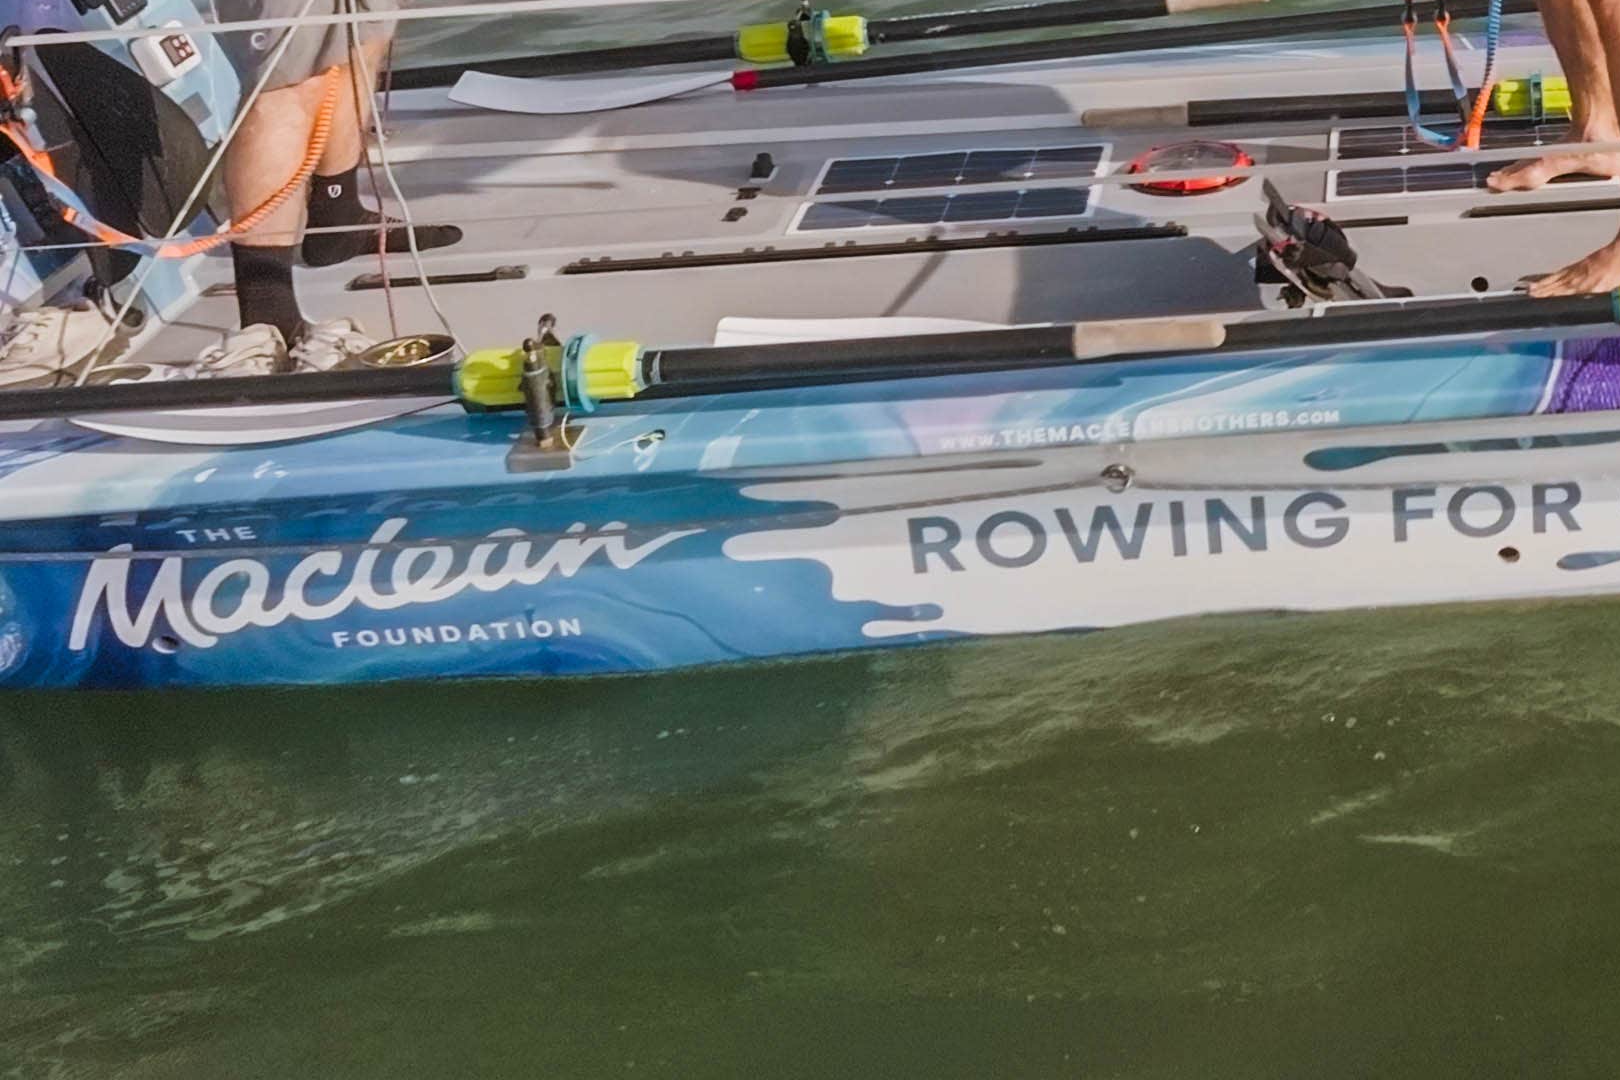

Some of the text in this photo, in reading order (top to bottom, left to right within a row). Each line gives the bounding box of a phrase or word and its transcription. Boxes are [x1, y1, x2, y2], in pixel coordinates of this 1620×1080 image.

[176, 525, 257, 544] THE
[907, 490, 1350, 574] ROWING
[1392, 480, 1582, 543] FOR
[67, 517, 708, 651] Maclean
[333, 618, 582, 649] FOUNDATION
